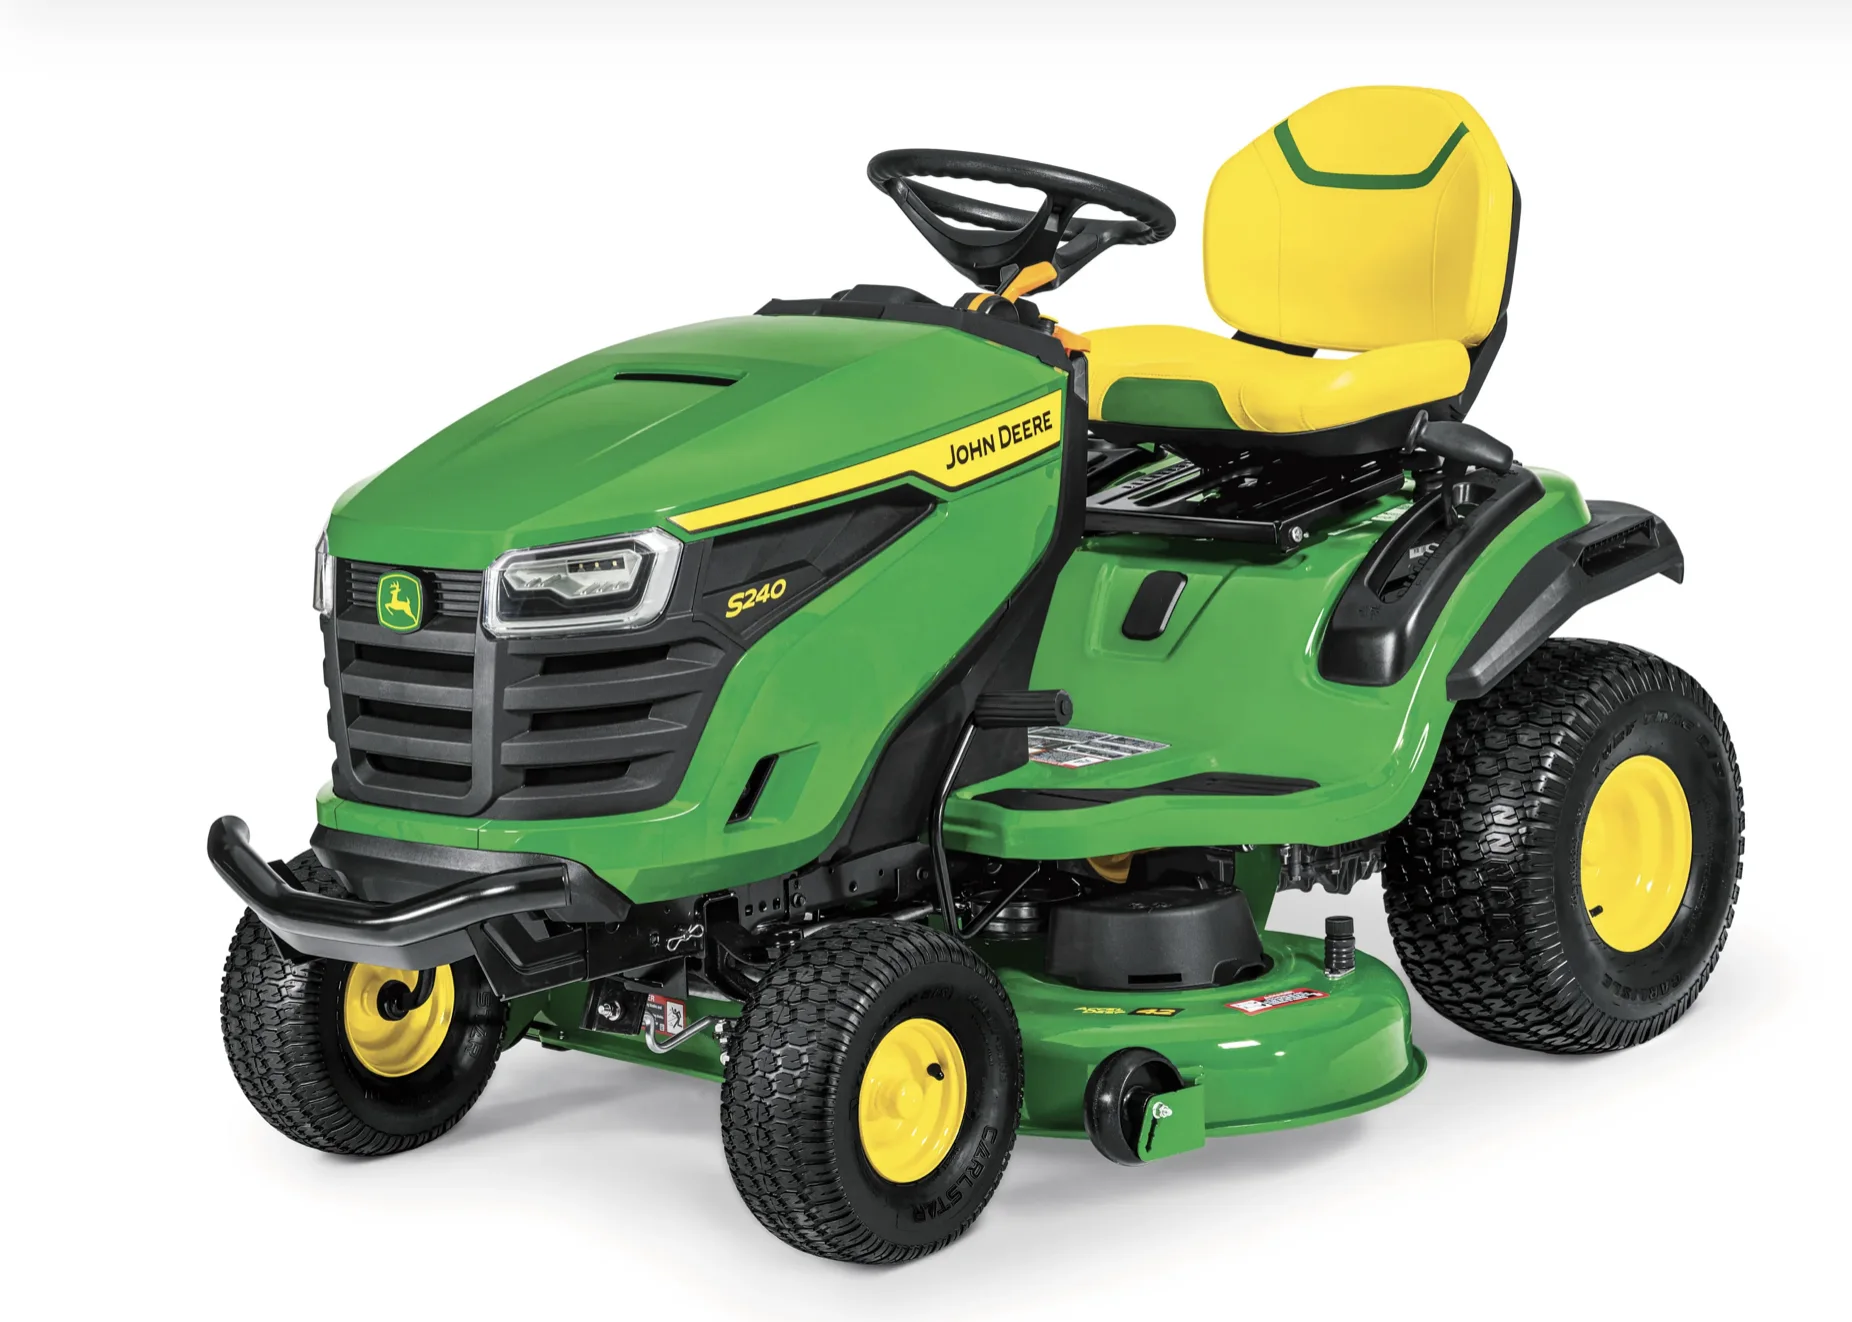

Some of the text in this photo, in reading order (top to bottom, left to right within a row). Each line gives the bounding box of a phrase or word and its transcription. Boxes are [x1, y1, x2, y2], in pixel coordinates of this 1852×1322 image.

[946, 410, 1053, 470] JOHN DEERE
[725, 578, 787, 618] S240
[912, 1125, 998, 1224] CARLSTAR
